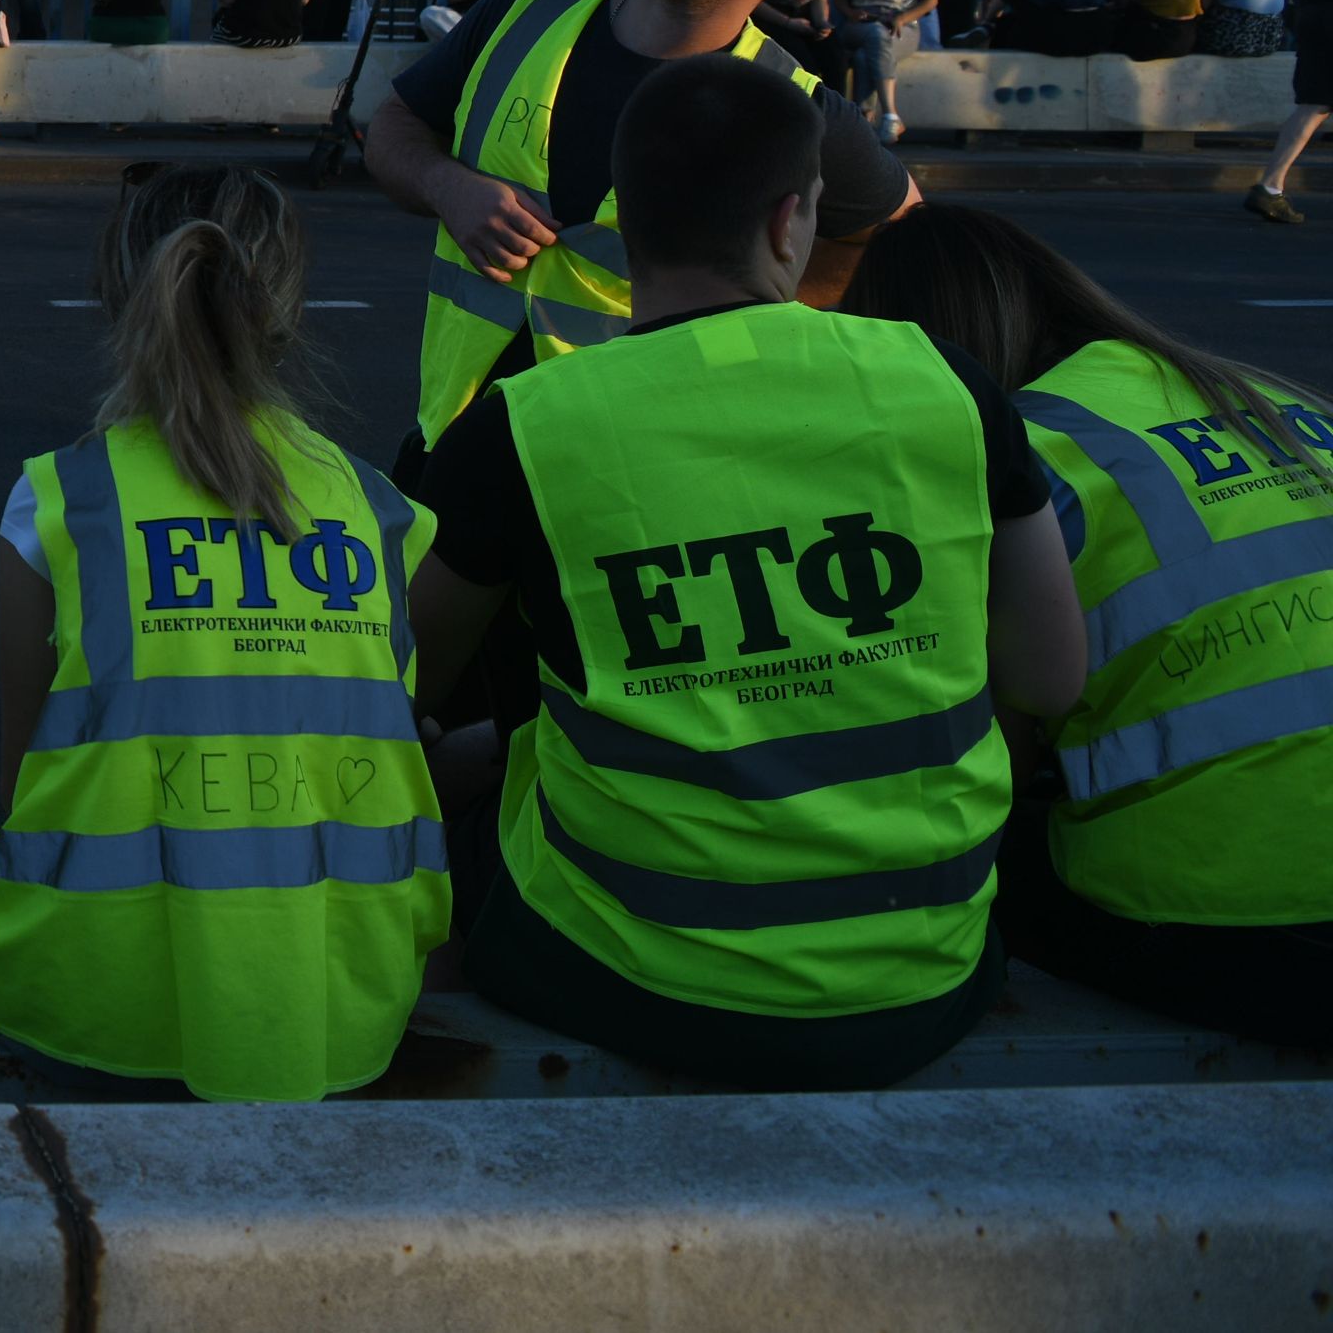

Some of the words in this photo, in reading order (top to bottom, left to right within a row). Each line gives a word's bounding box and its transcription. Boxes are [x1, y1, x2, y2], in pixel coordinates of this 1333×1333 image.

[135, 517, 377, 611] ЕТФ
[593, 511, 924, 671] ЕТФ
[140, 617, 307, 635] ЕЛЕКТРОТЕХНИЧКИ
[310, 619, 389, 639] ФАКУЛТЕТ
[233, 638, 307, 656] БЕОГРАД
[622, 653, 833, 698] ЕЛЕКТРОТЕХНИЧКИ
[837, 632, 941, 667] ФАКУЛТЕТ
[736, 678, 834, 705] БЕОГРАД
